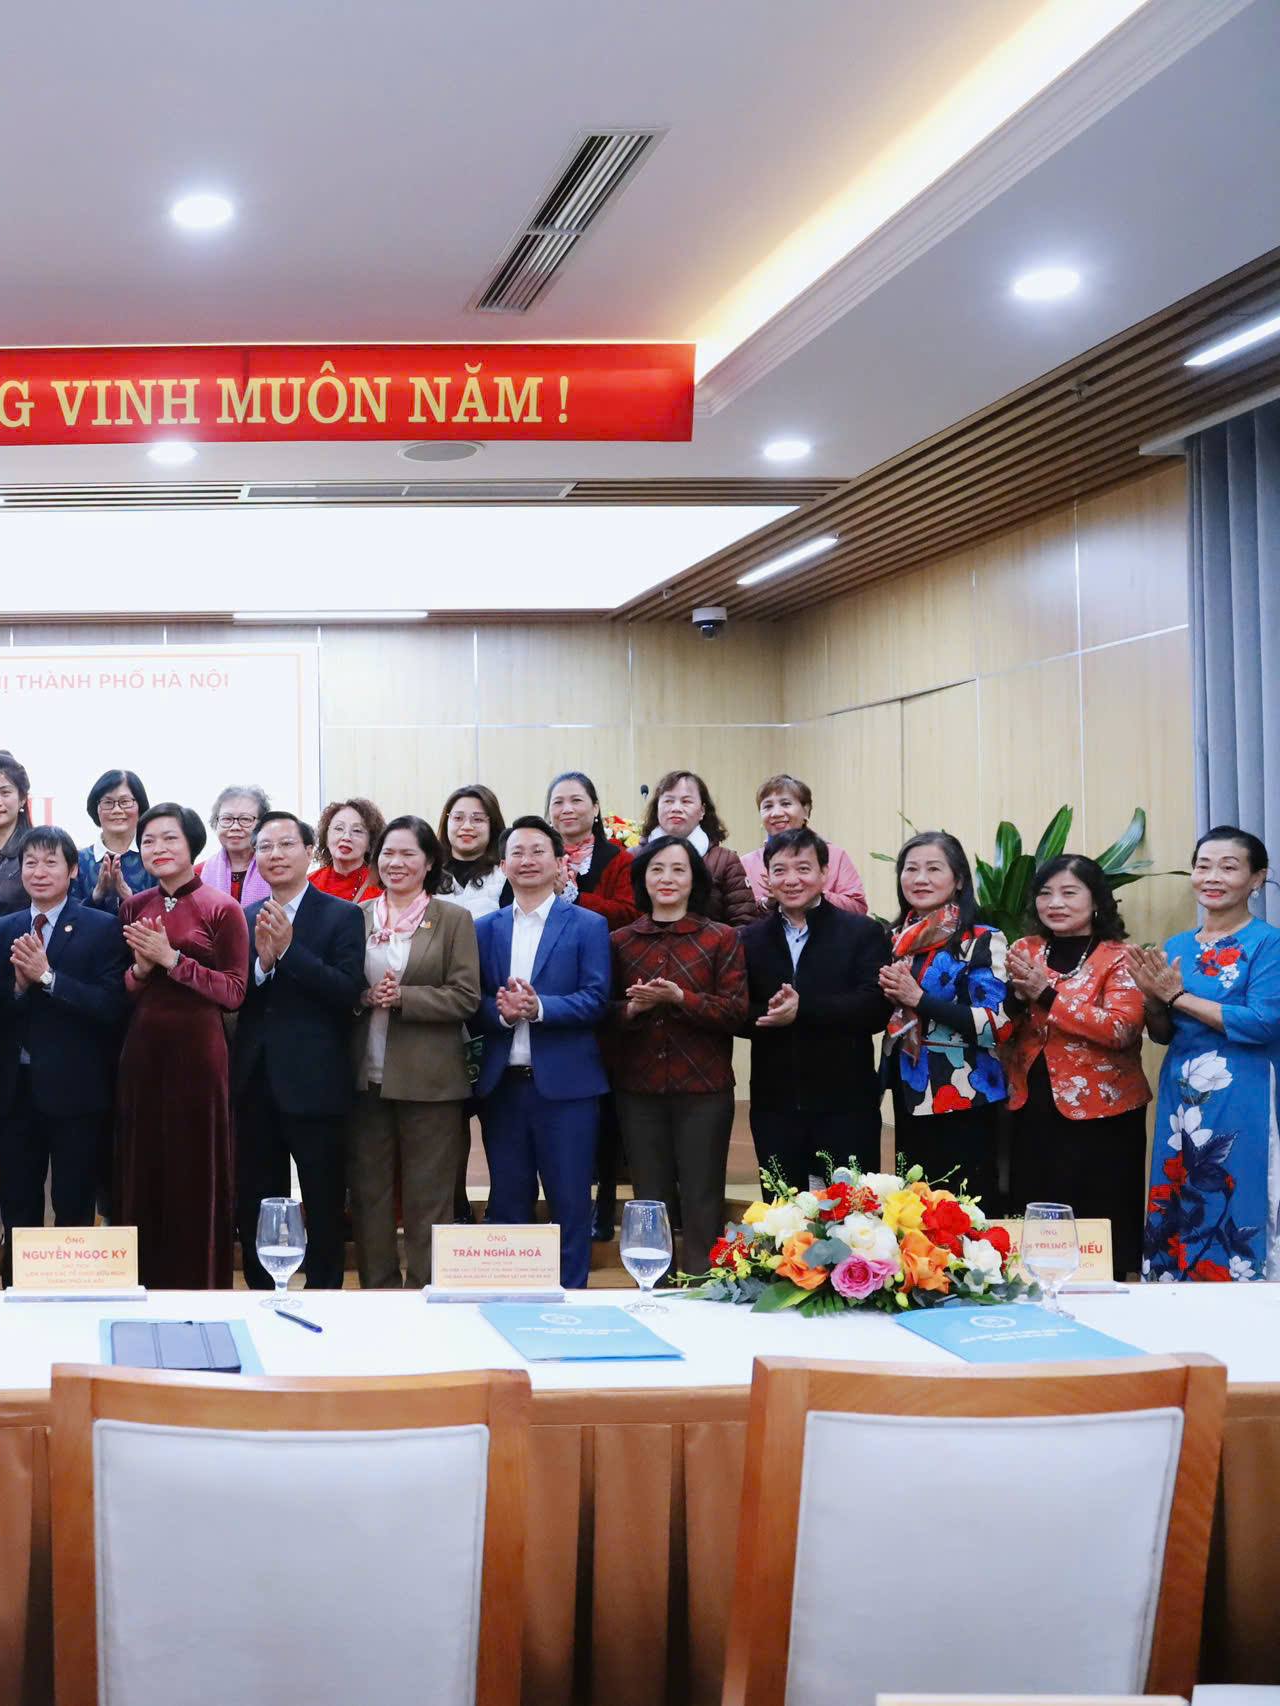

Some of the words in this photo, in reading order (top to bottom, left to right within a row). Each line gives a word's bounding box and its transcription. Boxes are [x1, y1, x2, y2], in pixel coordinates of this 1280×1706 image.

[50, 378, 201, 427] VINH
[216, 360, 392, 425] MUÔN
[408, 362, 544, 424] NĂM
[15, 669, 91, 691] THÀNH
[98, 667, 145, 690] PHỐ
[151, 668, 182, 690] HÀ
[189, 665, 230, 692] NỘI
[64, 1235, 85, 1245] ÔNG
[487, 1232, 508, 1242] ÔNG
